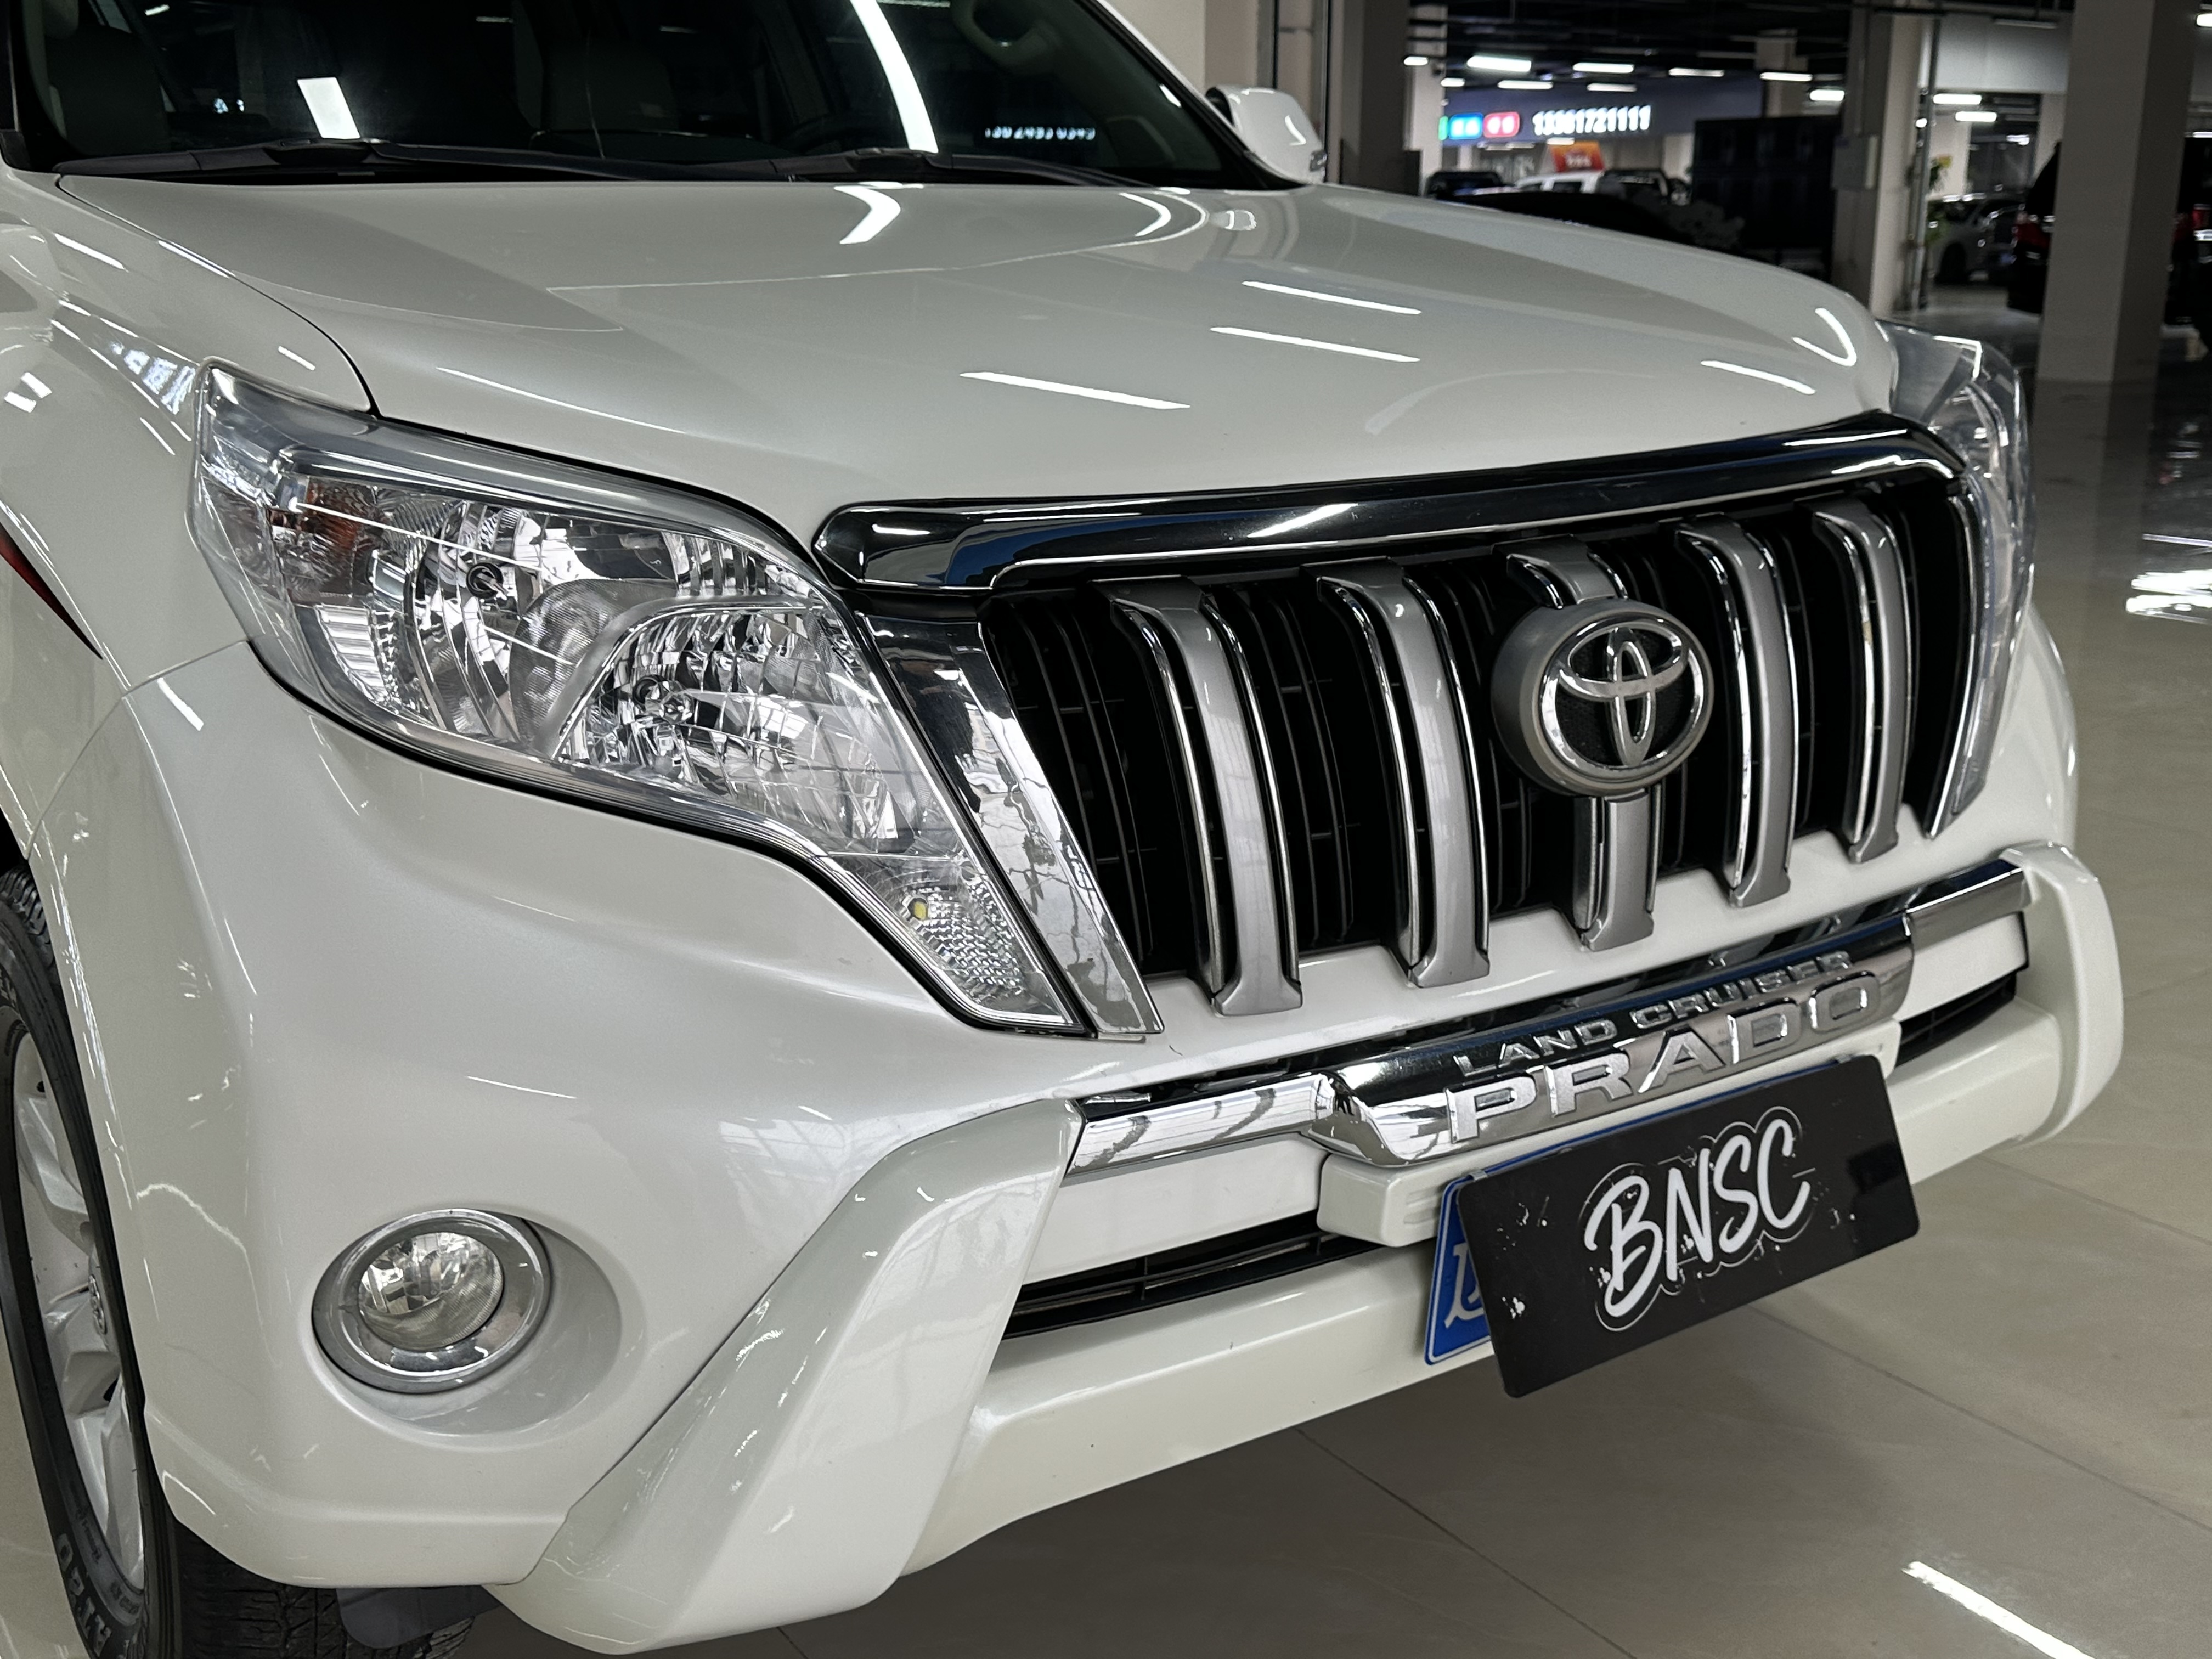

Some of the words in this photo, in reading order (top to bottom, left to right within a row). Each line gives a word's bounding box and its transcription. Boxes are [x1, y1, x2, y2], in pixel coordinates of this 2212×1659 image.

[1445, 971, 1881, 1143] PRADO
[1453, 1019, 1618, 1076] LAND
[1630, 951, 1853, 1029] CRUISER
[1584, 1119, 1810, 1317] BNSC
